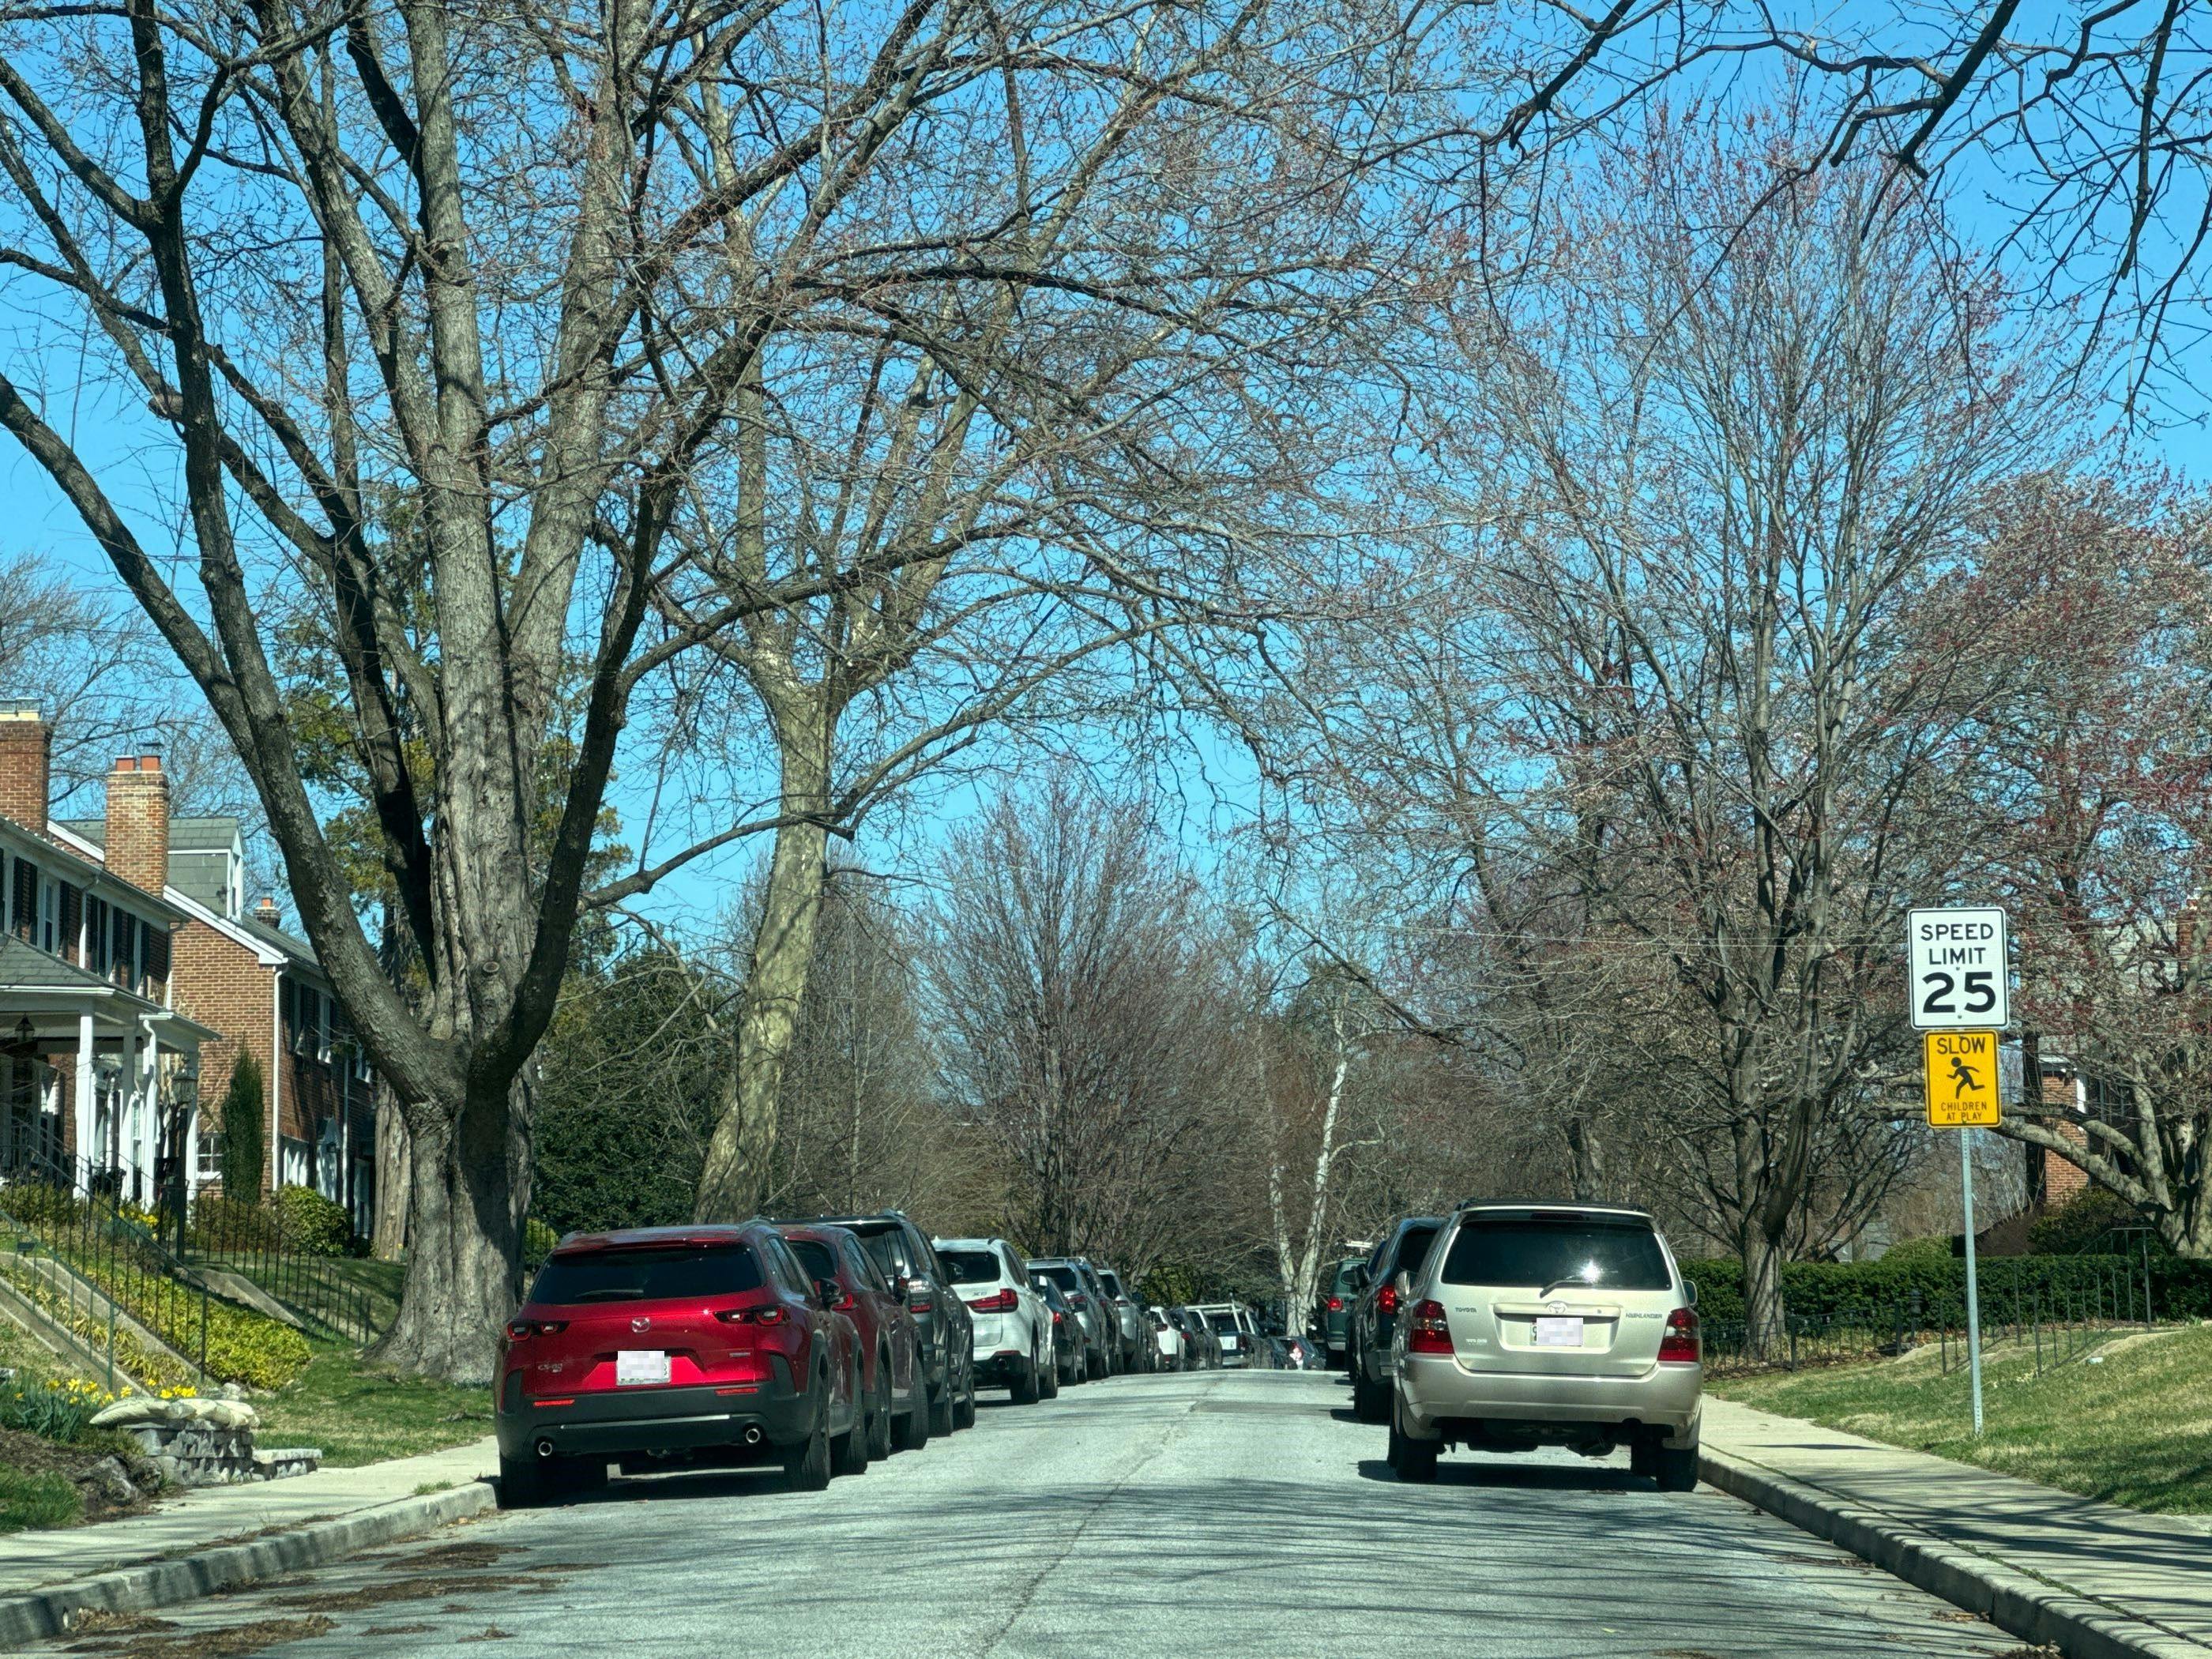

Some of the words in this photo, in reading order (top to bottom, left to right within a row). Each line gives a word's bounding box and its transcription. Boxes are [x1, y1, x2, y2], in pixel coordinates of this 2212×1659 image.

[1920, 924, 1994, 941] SPEED
[1928, 948, 1986, 965] LIMIT
[1922, 972, 1996, 1013] 25
[1936, 1037, 1986, 1054] SLOW
[1940, 1102, 1988, 1111] CHILDREN
[1946, 1112, 1956, 1121] AT
[1961, 1112, 1982, 1121] PLAY
